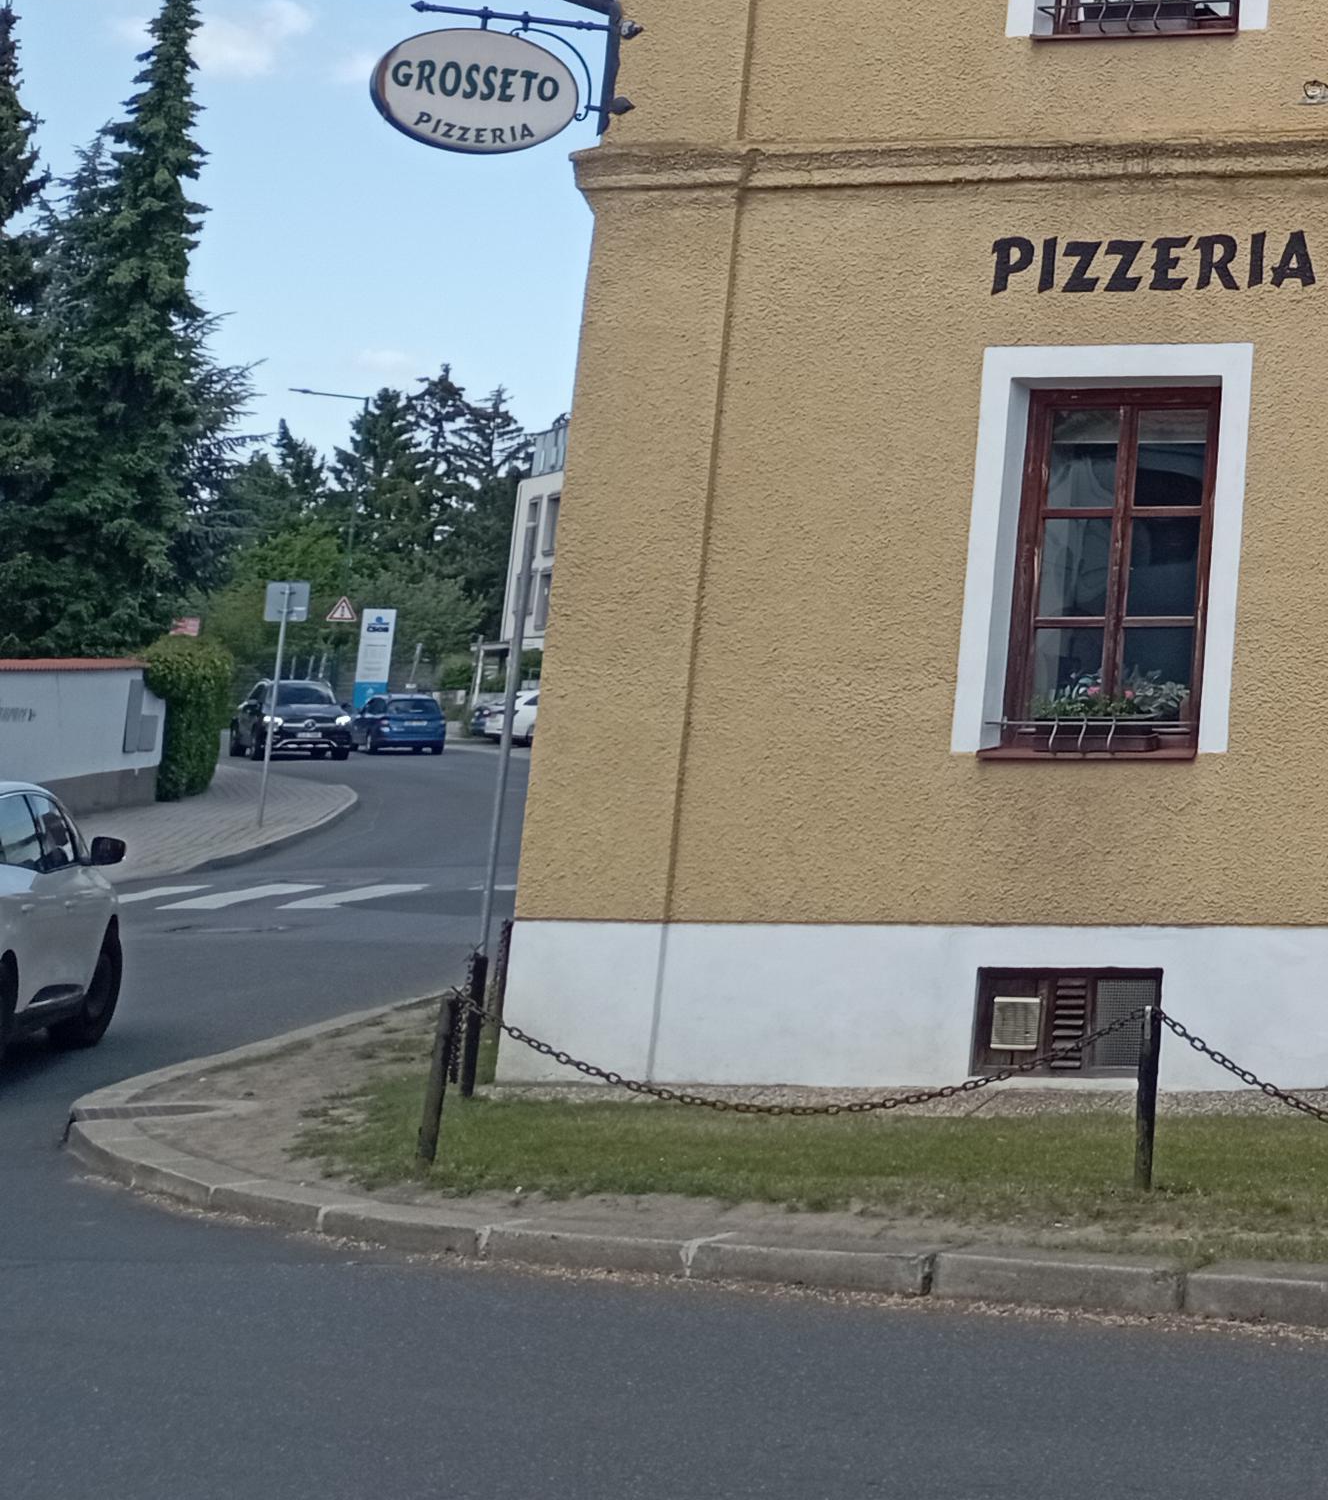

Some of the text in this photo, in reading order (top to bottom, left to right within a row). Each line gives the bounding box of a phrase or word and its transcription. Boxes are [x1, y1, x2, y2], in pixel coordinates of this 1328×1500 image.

[391, 59, 560, 103] GROSSETO
[413, 111, 535, 145] PIZZERIA
[990, 229, 1316, 296] PIZZERIA
